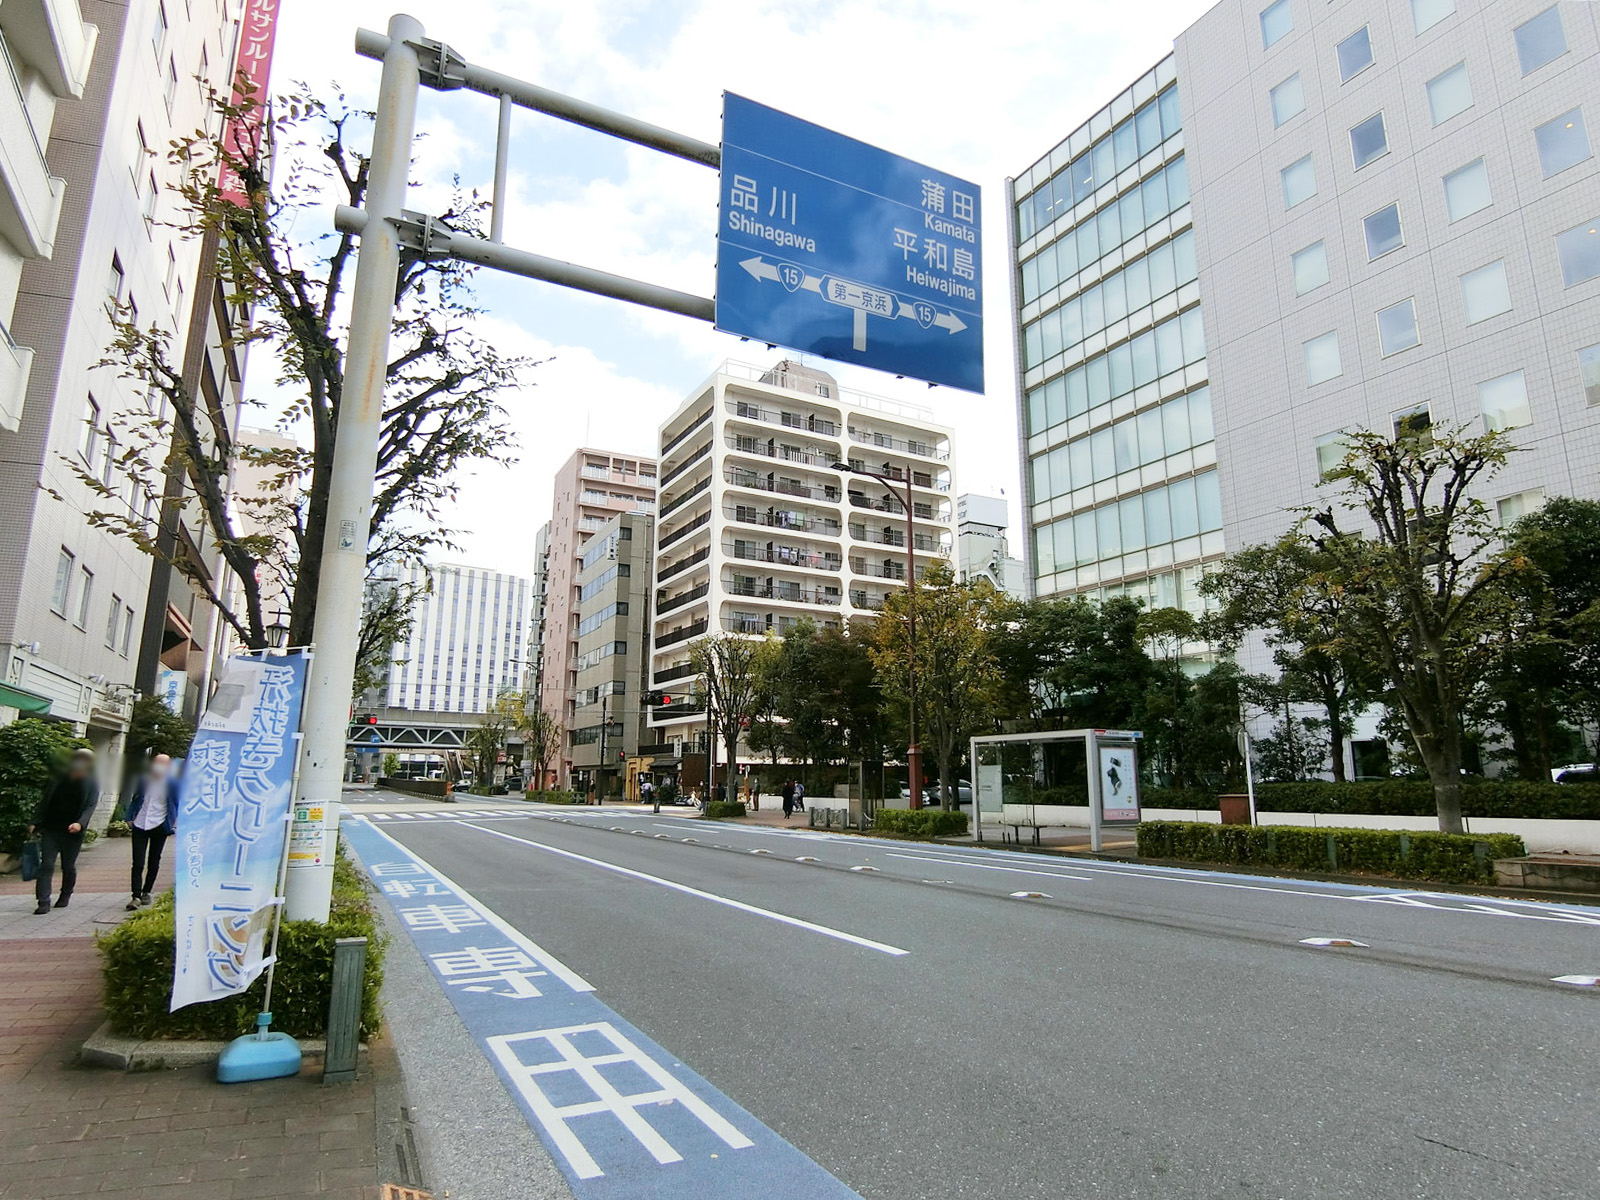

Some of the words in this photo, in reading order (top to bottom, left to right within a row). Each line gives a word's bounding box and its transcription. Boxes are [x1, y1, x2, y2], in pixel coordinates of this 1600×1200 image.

[730, 174, 797, 225] 品川
[921, 179, 974, 224] 蒲田
[729, 211, 816, 253] Shinagawa
[925, 213, 975, 243] Kamata
[893, 227, 975, 281] 平和島
[783, 268, 798, 284] 15
[906, 265, 976, 301] Heiwajima
[834, 283, 887, 312] 第一京浜
[918, 305, 931, 322] 15
[370, 862, 755, 1180] 自転車専用
